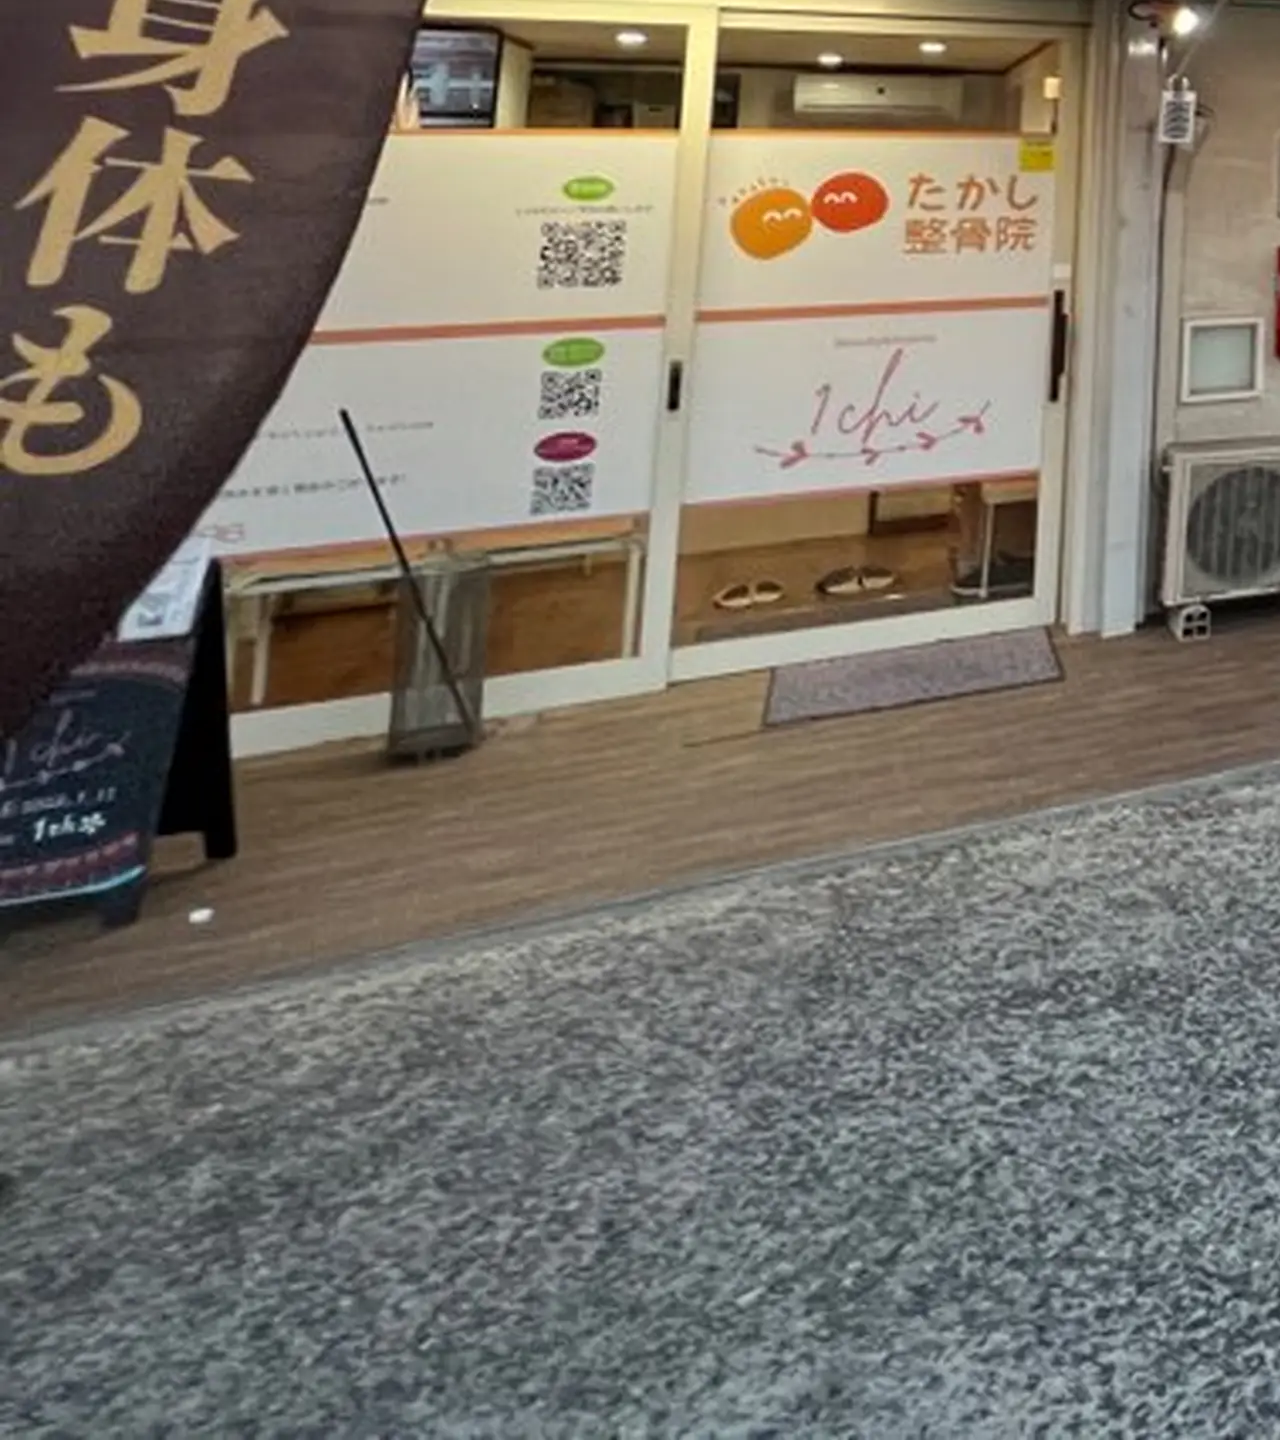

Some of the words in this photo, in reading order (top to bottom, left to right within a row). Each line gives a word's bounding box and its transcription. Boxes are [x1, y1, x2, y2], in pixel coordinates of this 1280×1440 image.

[906, 173, 1039, 211] たかし
[904, 216, 1038, 255] 整骨院
